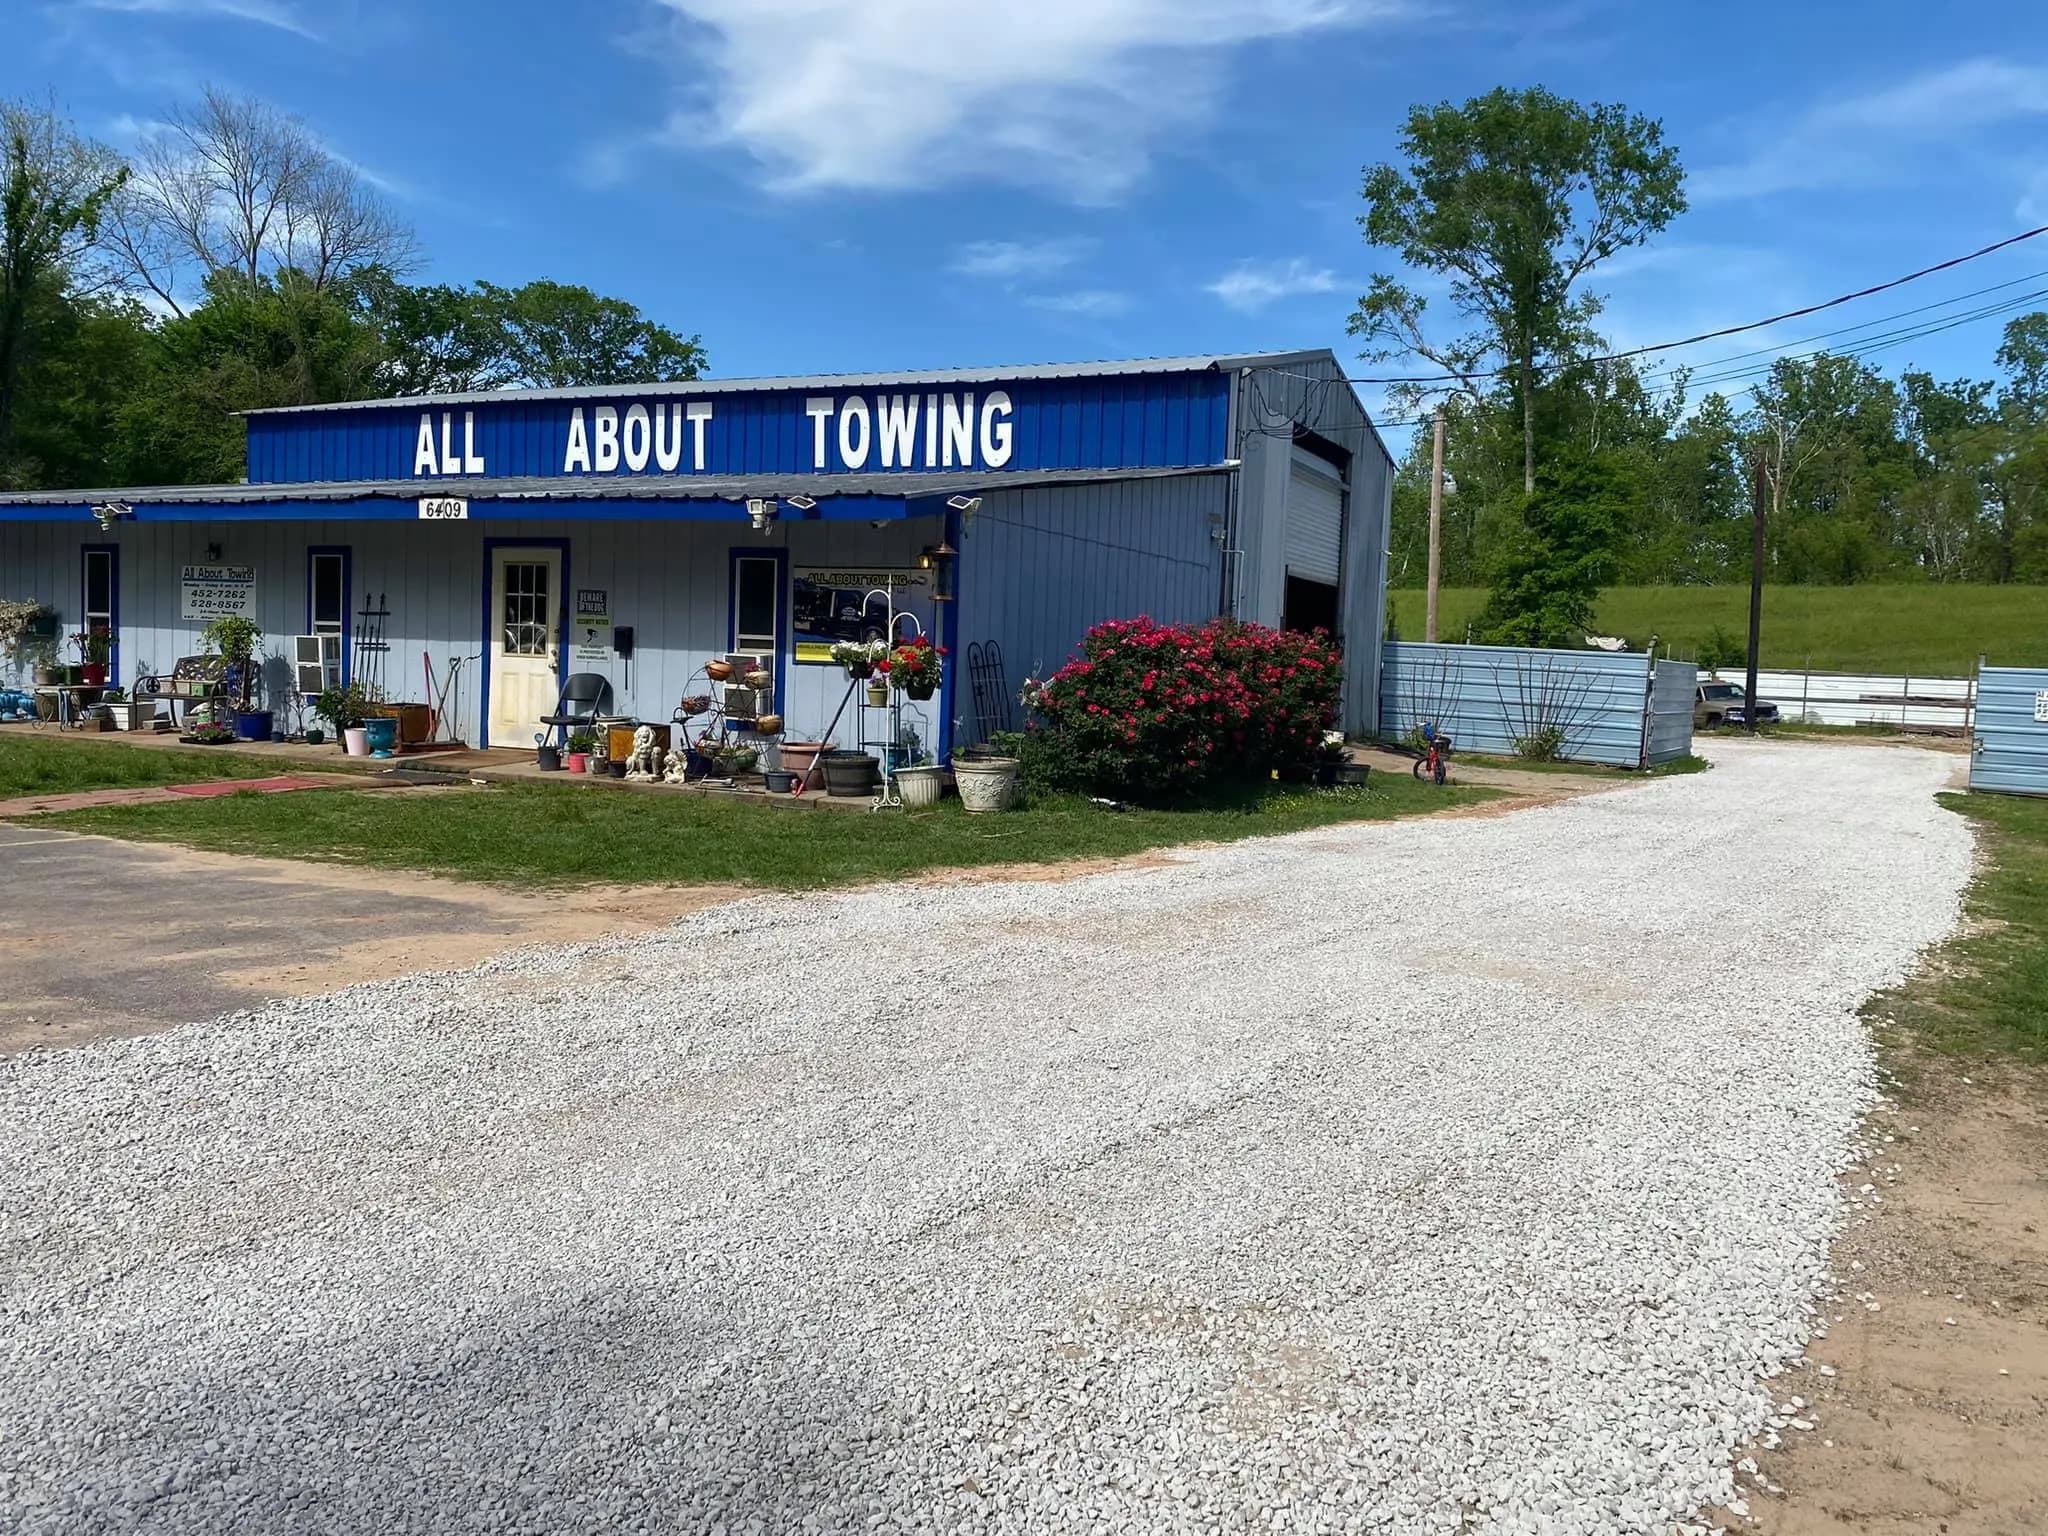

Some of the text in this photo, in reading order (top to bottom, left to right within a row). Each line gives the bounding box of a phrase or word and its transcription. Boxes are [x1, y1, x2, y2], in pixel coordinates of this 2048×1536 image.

[414, 391, 1013, 476] ALL ABOUT TOWING
[426, 501, 461, 518] 6409
[198, 567, 223, 578] About
[808, 572, 828, 585] ALL
[829, 573, 864, 586] ABOUT
[191, 589, 246, 599] 452-7262
[190, 600, 246, 609] 528-8567
